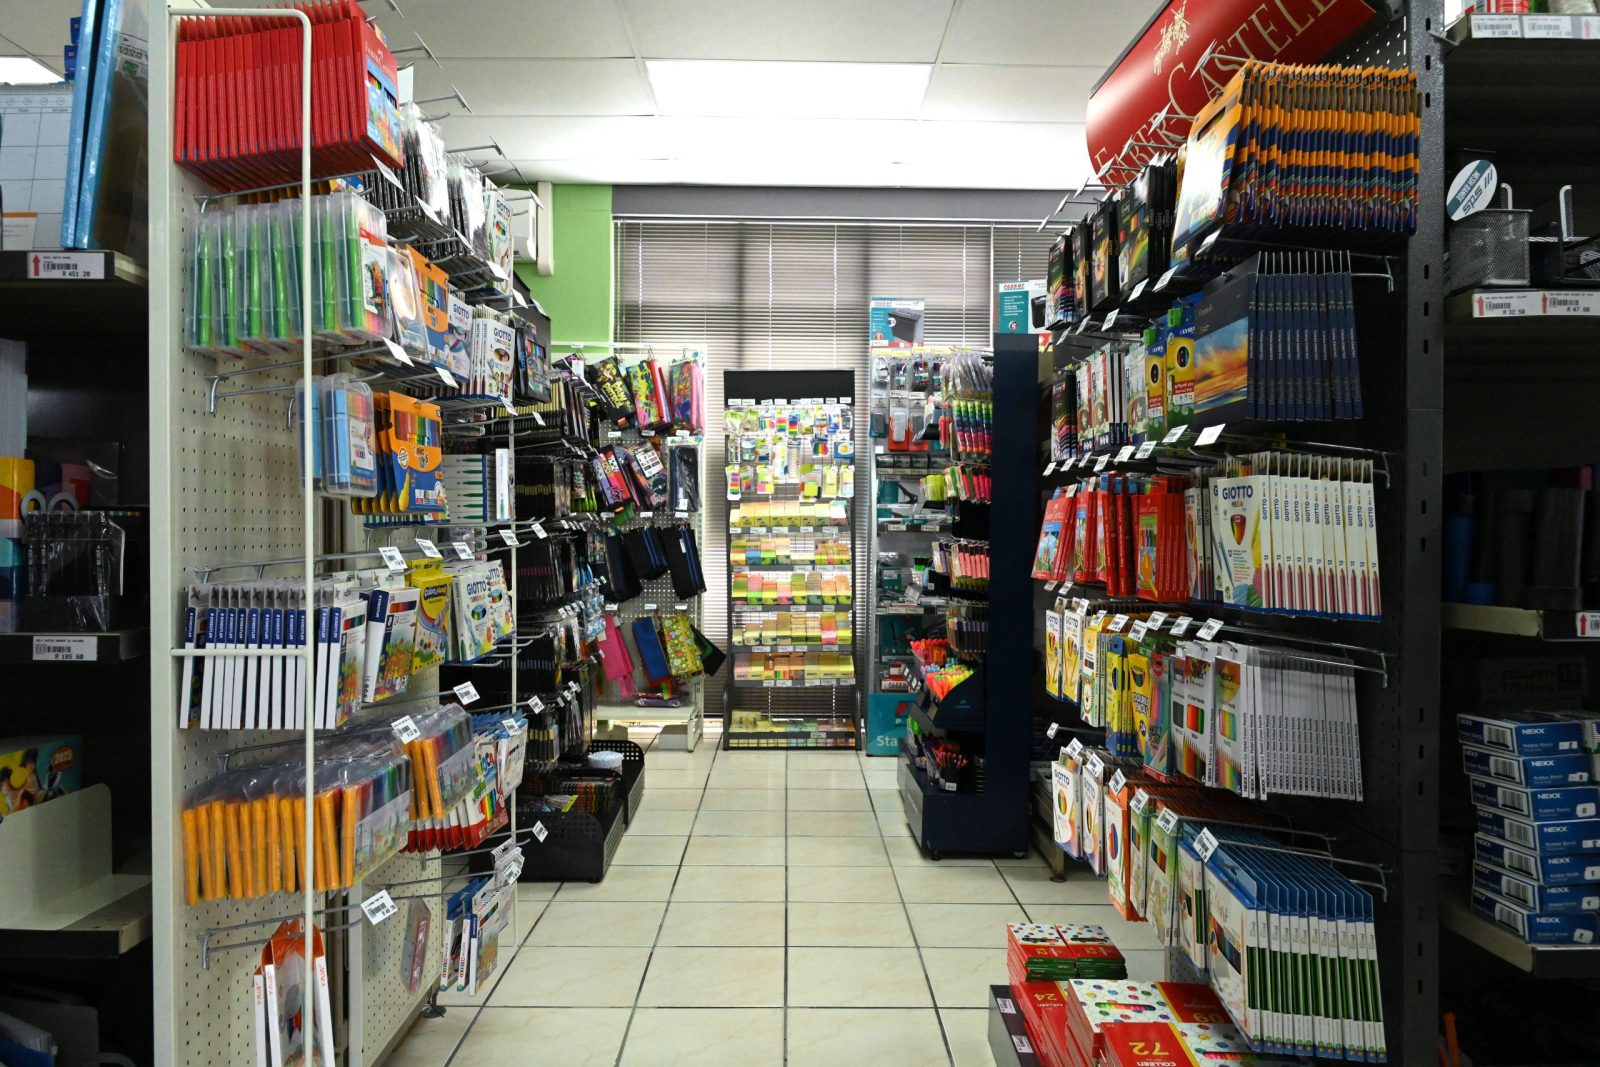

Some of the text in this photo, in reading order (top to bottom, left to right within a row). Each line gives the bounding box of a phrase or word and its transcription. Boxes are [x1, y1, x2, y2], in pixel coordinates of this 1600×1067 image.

[1455, 171, 1481, 203] MESH RANGE
[496, 199, 511, 218] GIOTTO
[453, 303, 470, 320] GIOTTO
[493, 327, 512, 342] GIOTTO
[1222, 485, 1254, 500] GIOTTO
[466, 580, 487, 596] GIOTTO
[1054, 768, 1070, 785] GIOTTO
[1546, 886, 1570, 894] NEXX
[1033, 992, 1058, 1001] 24
[1128, 1041, 1170, 1056] 72
